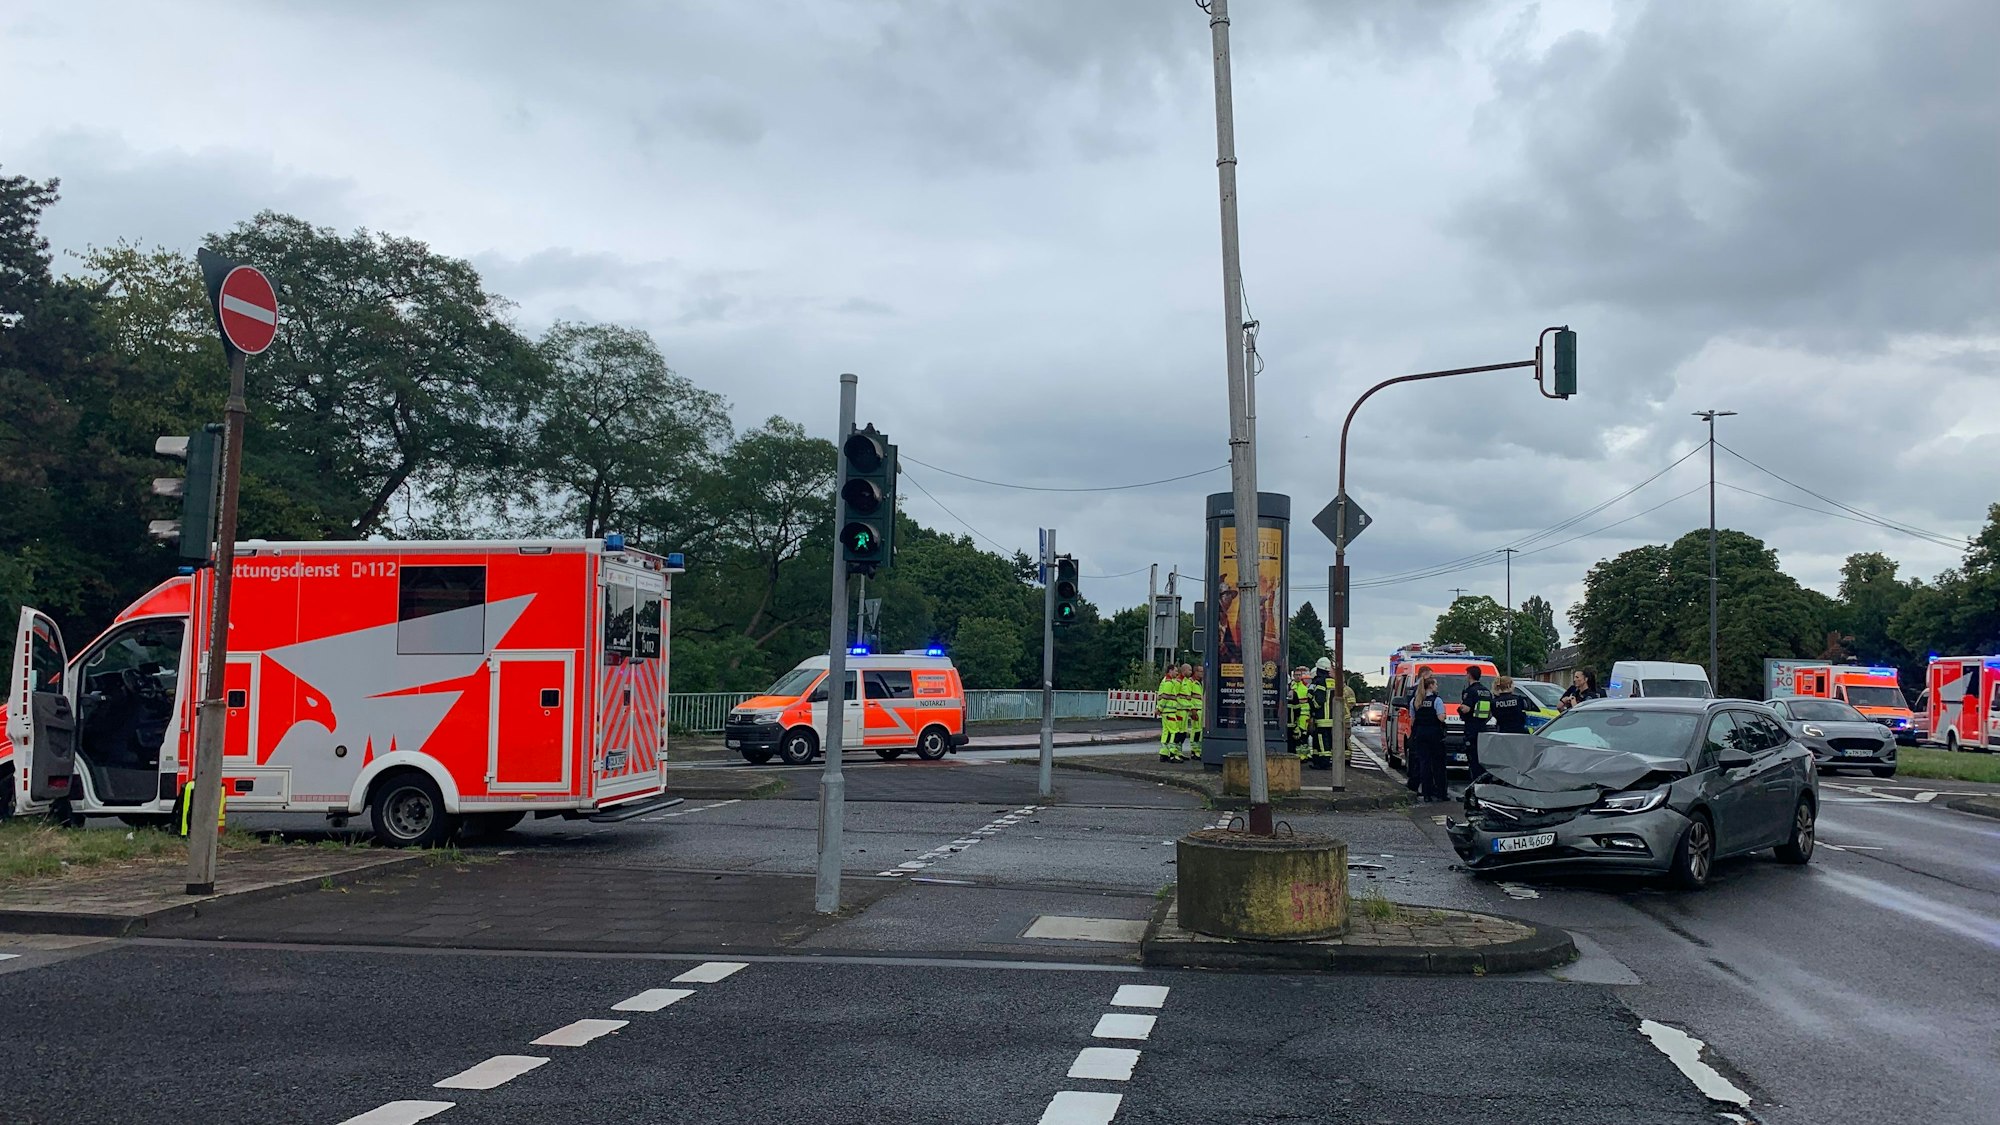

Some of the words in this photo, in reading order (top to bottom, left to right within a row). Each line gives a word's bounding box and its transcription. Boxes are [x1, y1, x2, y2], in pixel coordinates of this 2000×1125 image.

[1223, 541, 1279, 555] PPEJI
[368, 561, 396, 577] 112
[1500, 839, 1506, 850] K
[1513, 839, 1527, 849] HA
